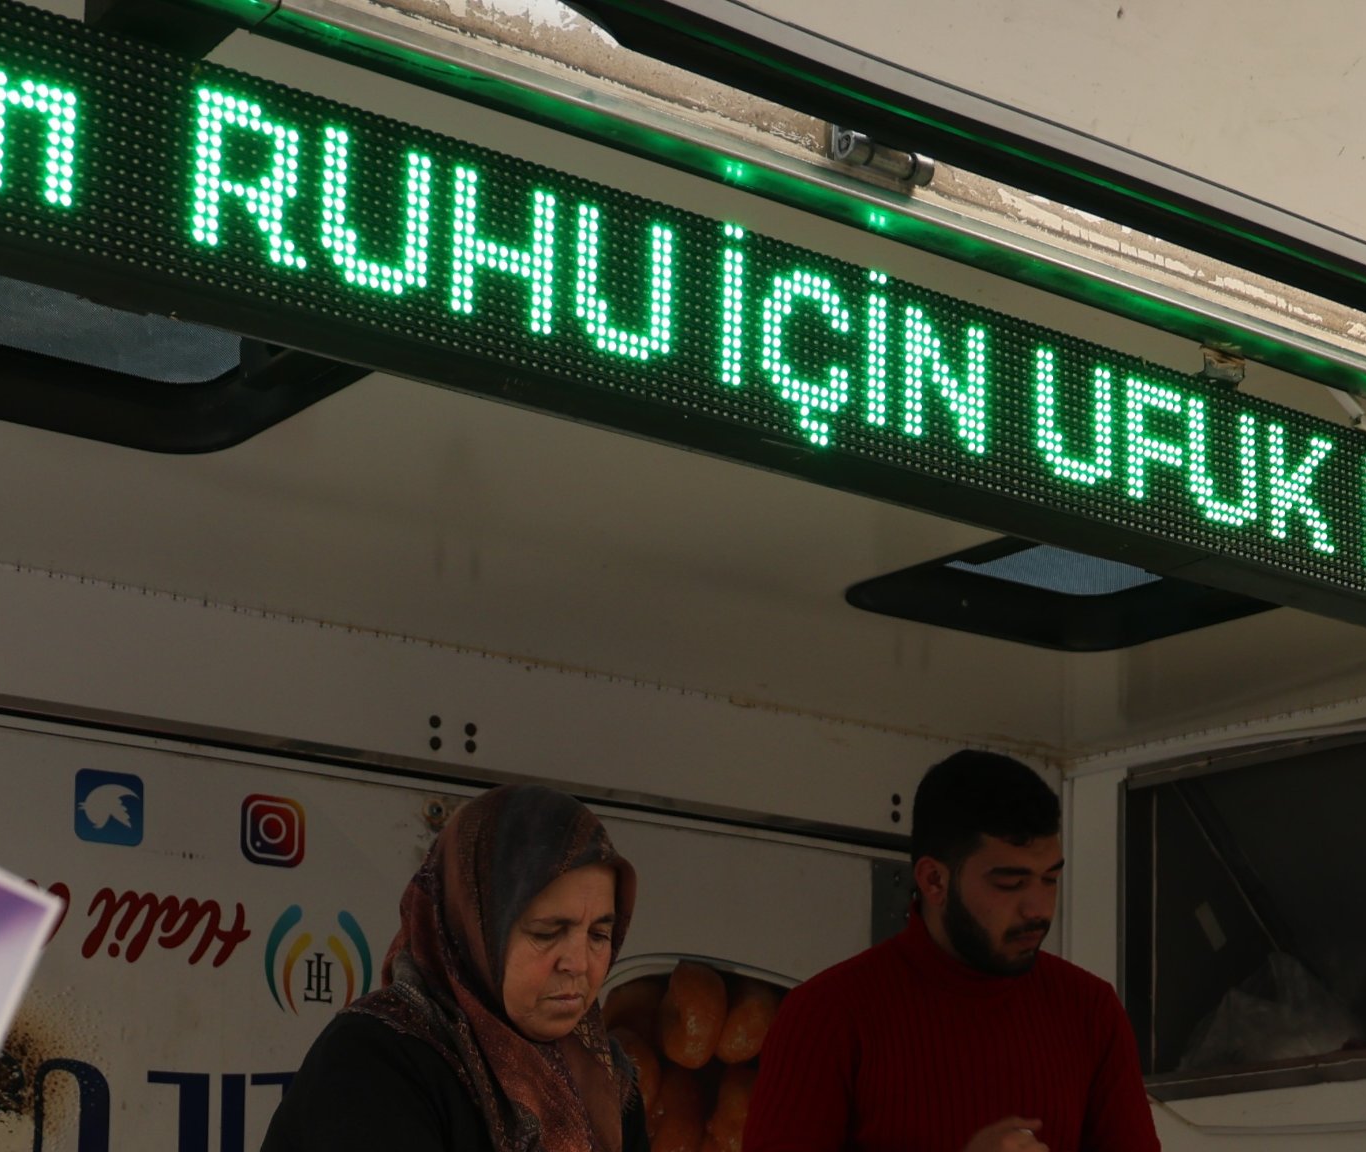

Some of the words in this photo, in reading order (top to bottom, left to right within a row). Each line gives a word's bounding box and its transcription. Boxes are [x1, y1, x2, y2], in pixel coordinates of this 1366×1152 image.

[191, 87, 673, 361] RUHU
[720, 222, 986, 455] İÇİN
[1035, 347, 1335, 555] UFUK
[81, 886, 251, 968] Halil
